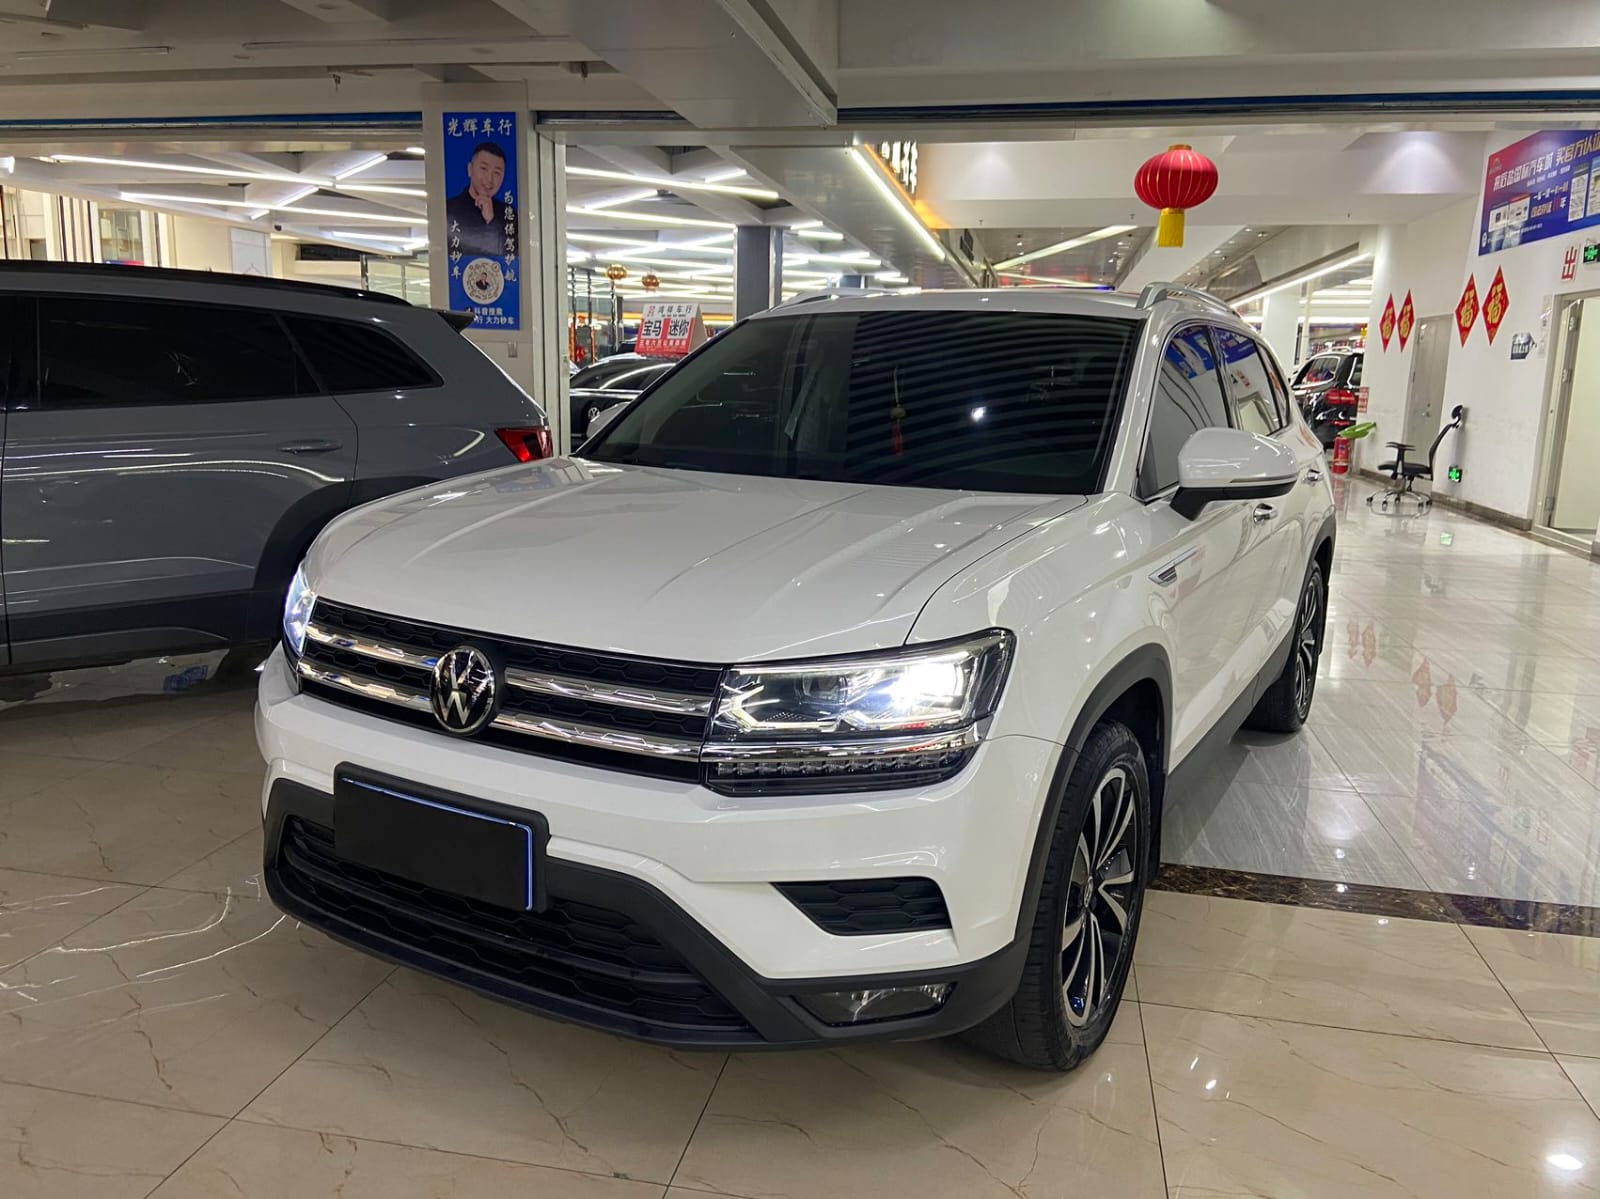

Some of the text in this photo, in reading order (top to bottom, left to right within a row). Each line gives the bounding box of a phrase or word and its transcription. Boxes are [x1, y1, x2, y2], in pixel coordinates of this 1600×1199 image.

[448, 118, 513, 138] 光辉车行
[1460, 289, 1475, 328] 福
[1488, 282, 1503, 325] 福
[642, 319, 690, 336] 宝马 迷你
